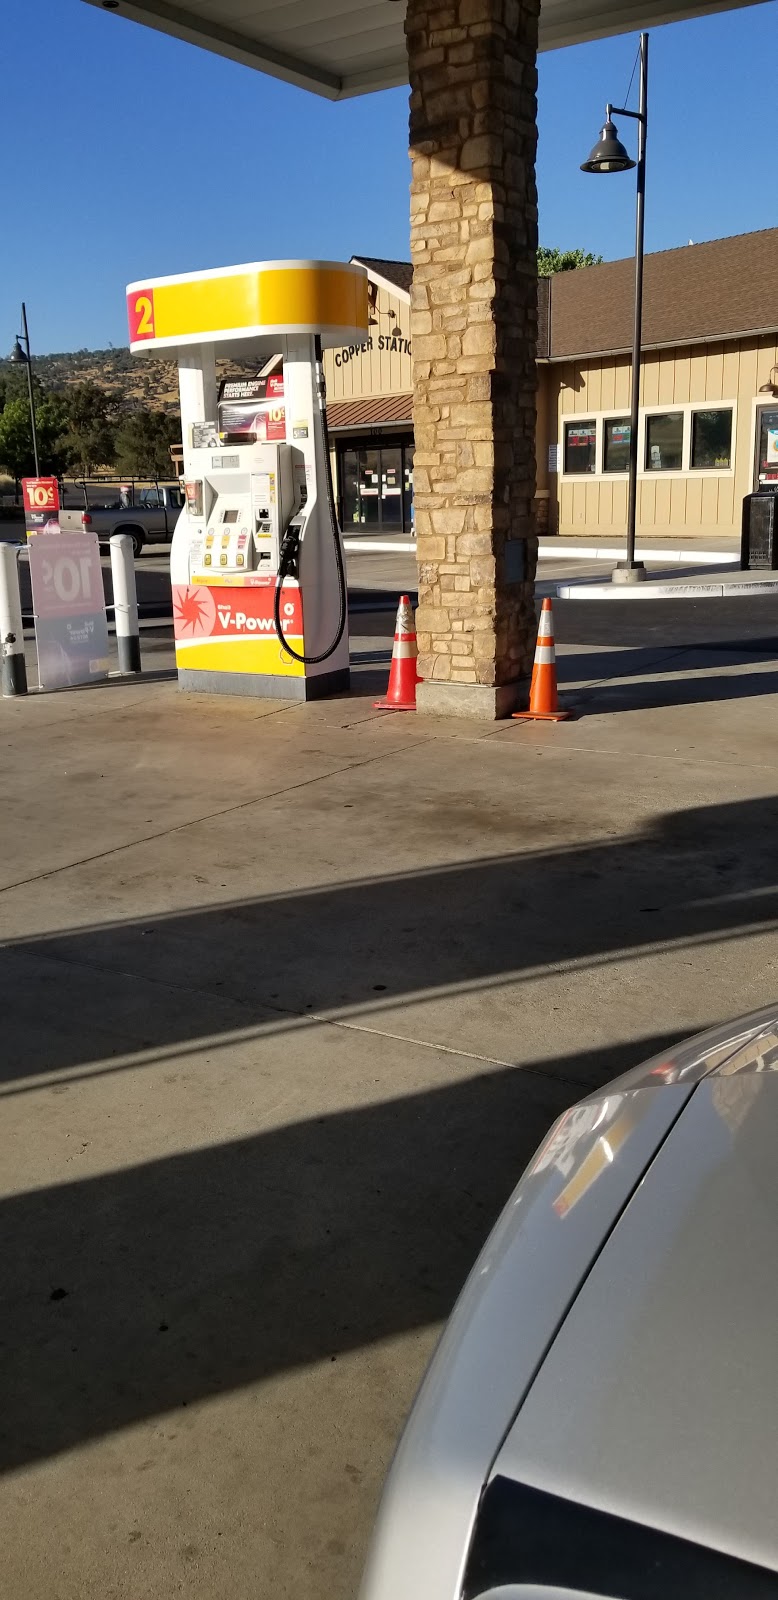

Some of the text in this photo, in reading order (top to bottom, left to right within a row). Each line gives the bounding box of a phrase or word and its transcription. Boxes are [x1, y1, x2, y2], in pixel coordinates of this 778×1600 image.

[135, 296, 153, 335] 2
[335, 336, 373, 367] COPPER
[26, 486, 54, 506] 10¢
